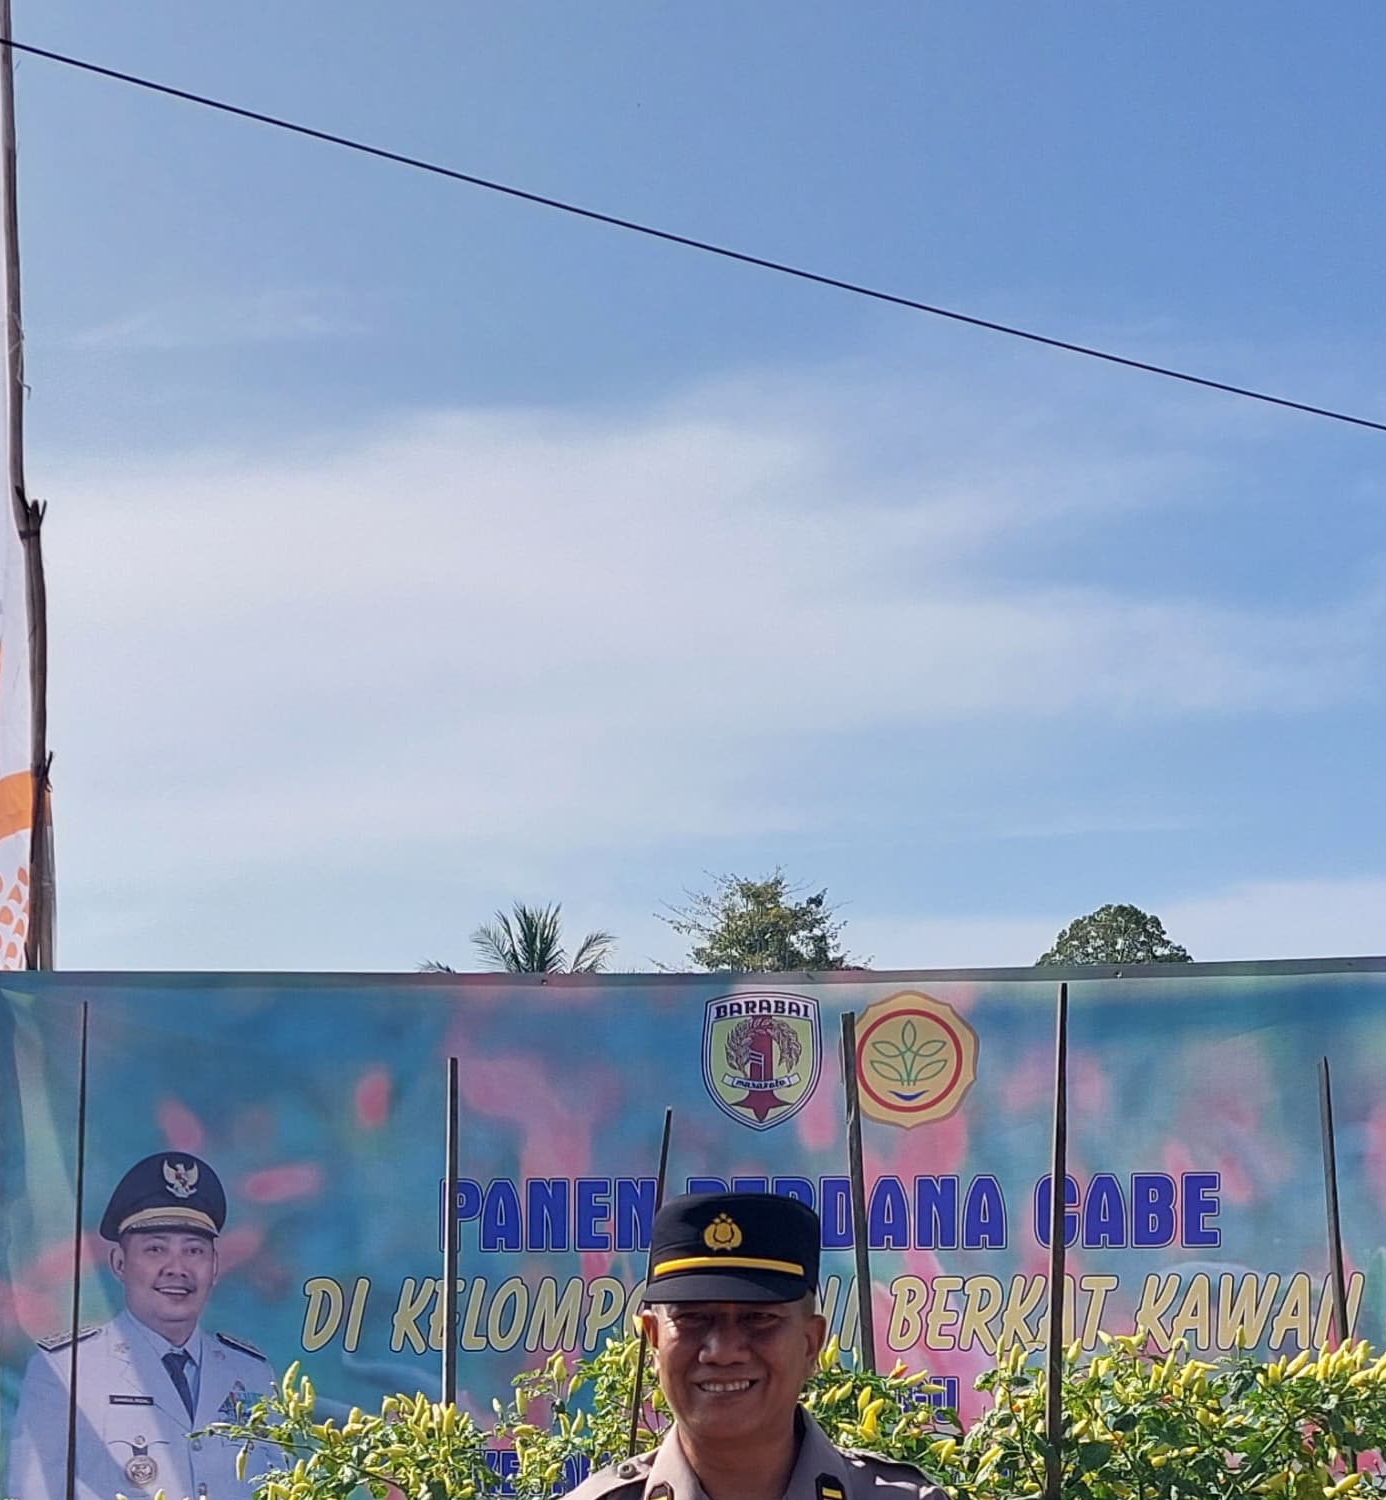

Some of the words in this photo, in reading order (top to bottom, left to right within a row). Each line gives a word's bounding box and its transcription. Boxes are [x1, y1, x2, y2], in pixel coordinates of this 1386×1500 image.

[714, 999, 811, 1019] BARABAI
[440, 1178, 659, 1253] PANEN
[1033, 1172, 1221, 1250] CABE
[301, 1275, 371, 1353] DI
[1134, 1271, 1366, 1353] KAWAN
